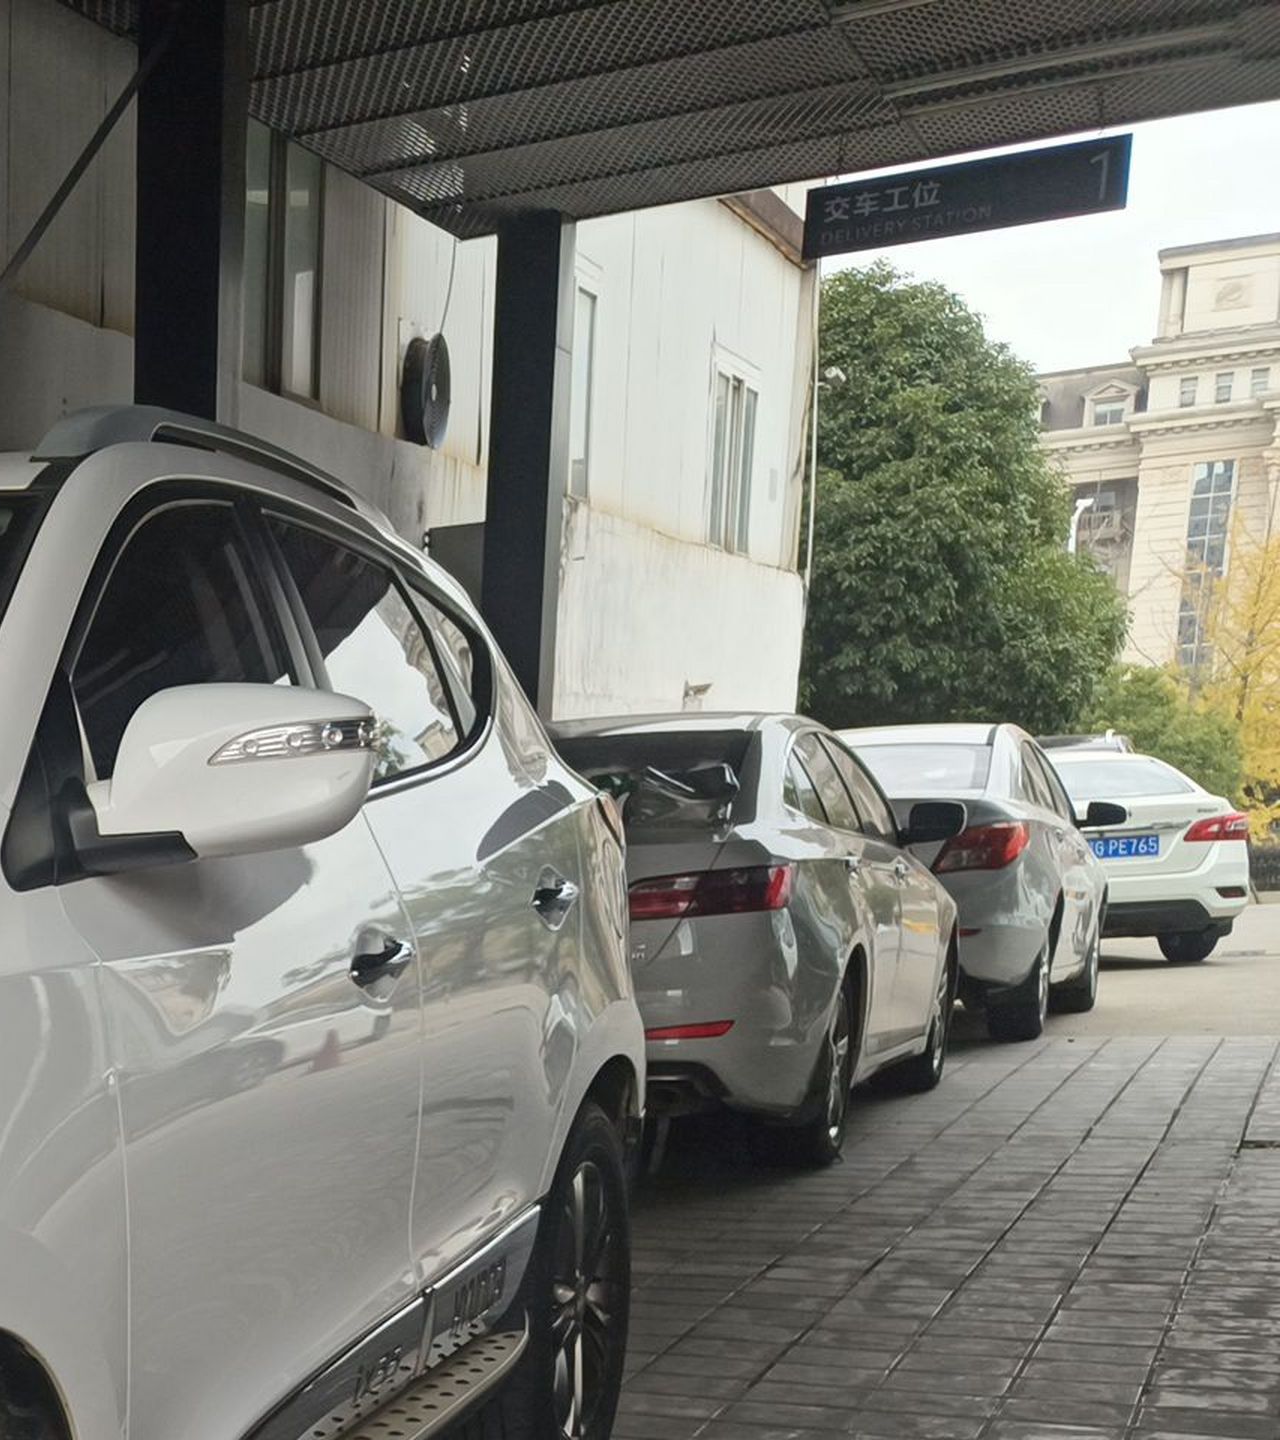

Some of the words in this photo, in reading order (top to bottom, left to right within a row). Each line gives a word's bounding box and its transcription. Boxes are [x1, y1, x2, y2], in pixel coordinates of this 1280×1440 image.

[1090, 150, 1111, 201] 1
[823, 179, 941, 224] 交车工位
[821, 218, 906, 246] DELIVERY
[911, 204, 991, 231] STATION
